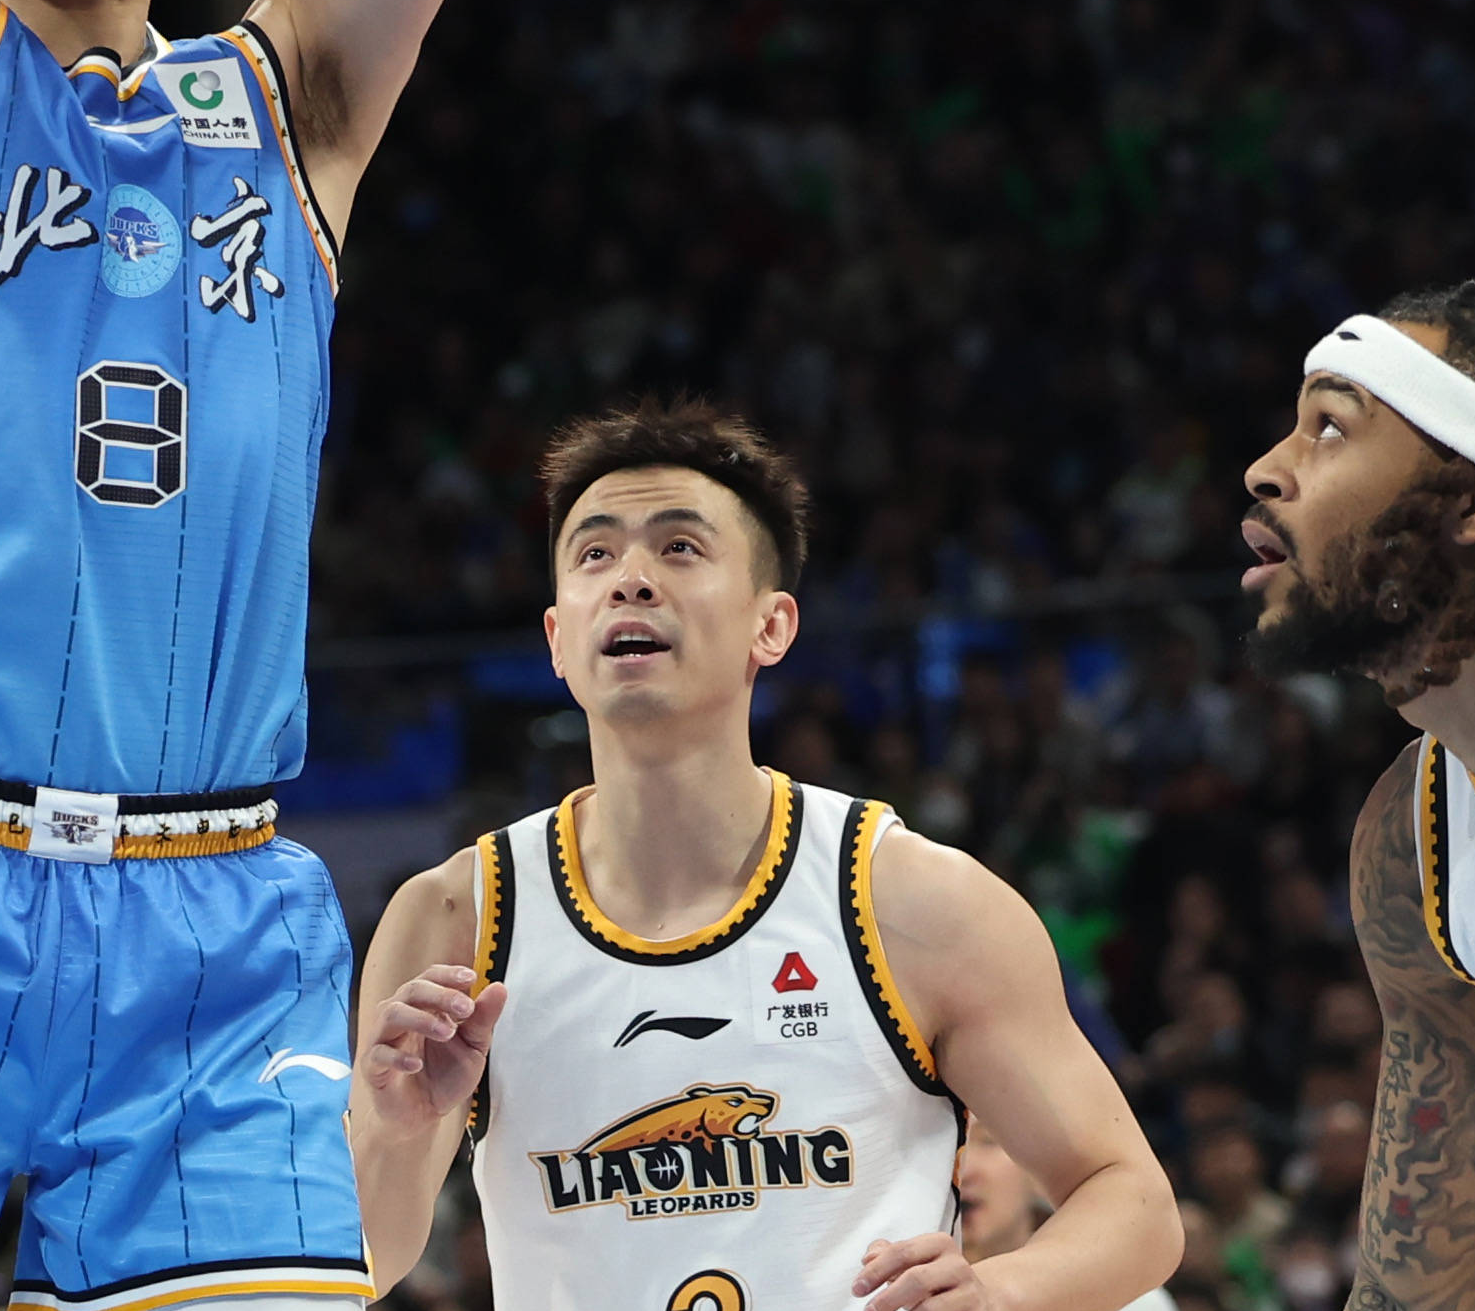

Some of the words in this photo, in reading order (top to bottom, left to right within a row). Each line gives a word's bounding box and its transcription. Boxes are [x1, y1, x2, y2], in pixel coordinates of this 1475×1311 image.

[180, 116, 248, 130] 中国人寿
[183, 129, 221, 139] CHINA
[223, 132, 251, 140] LIFE
[75, 360, 187, 509] 8
[52, 810, 99, 827] DUCKS
[766, 1002, 829, 1020] 广发银行
[780, 1022, 819, 1039] CGB
[532, 1123, 854, 1212] LIAONING
[628, 1190, 757, 1217] LEOPARDS
